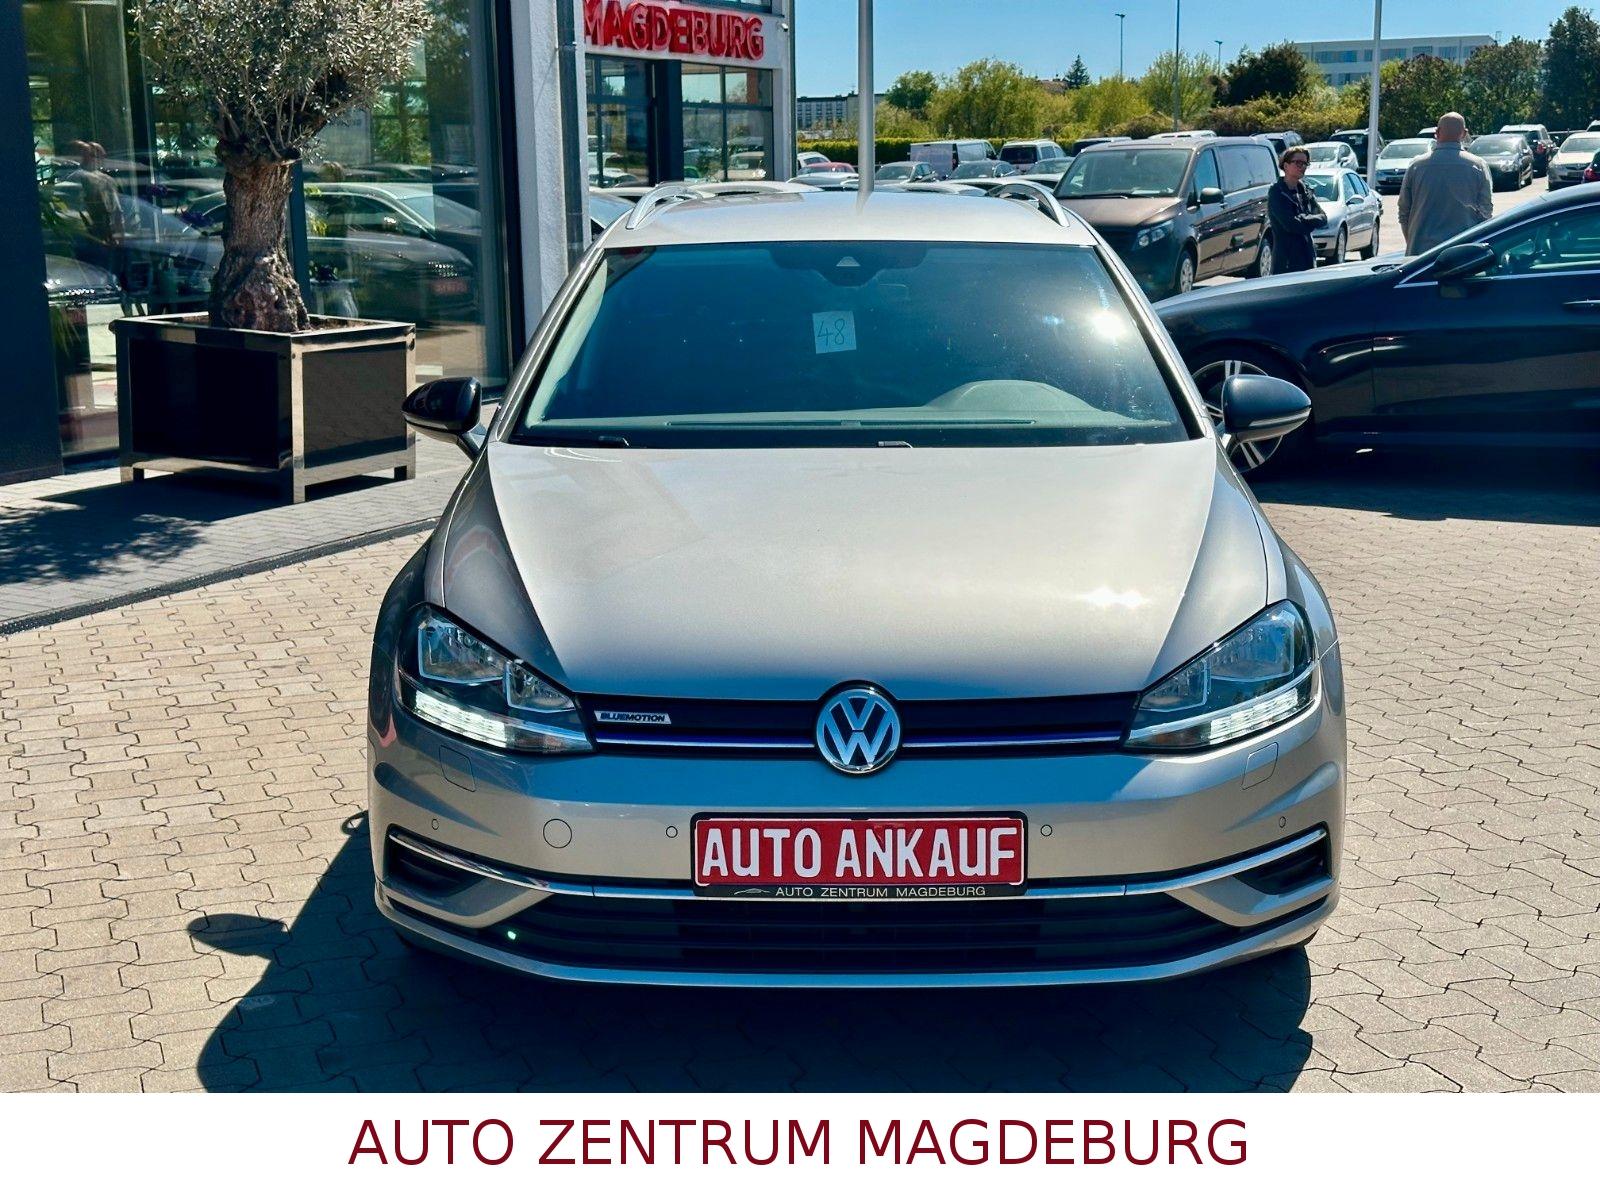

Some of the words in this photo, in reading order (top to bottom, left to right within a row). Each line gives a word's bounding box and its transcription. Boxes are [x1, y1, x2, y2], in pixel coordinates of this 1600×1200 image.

[584, 0, 764, 60] MAGDEBURG
[817, 318, 846, 347] 48
[600, 711, 666, 723] BLUEMOTION
[824, 696, 892, 768] VW
[701, 827, 822, 878] AUTO
[834, 826, 1018, 878] ANKAUF
[775, 886, 814, 898] AUTO
[820, 886, 889, 898] ZENTRUM
[895, 886, 986, 898] MAGDEBURG
